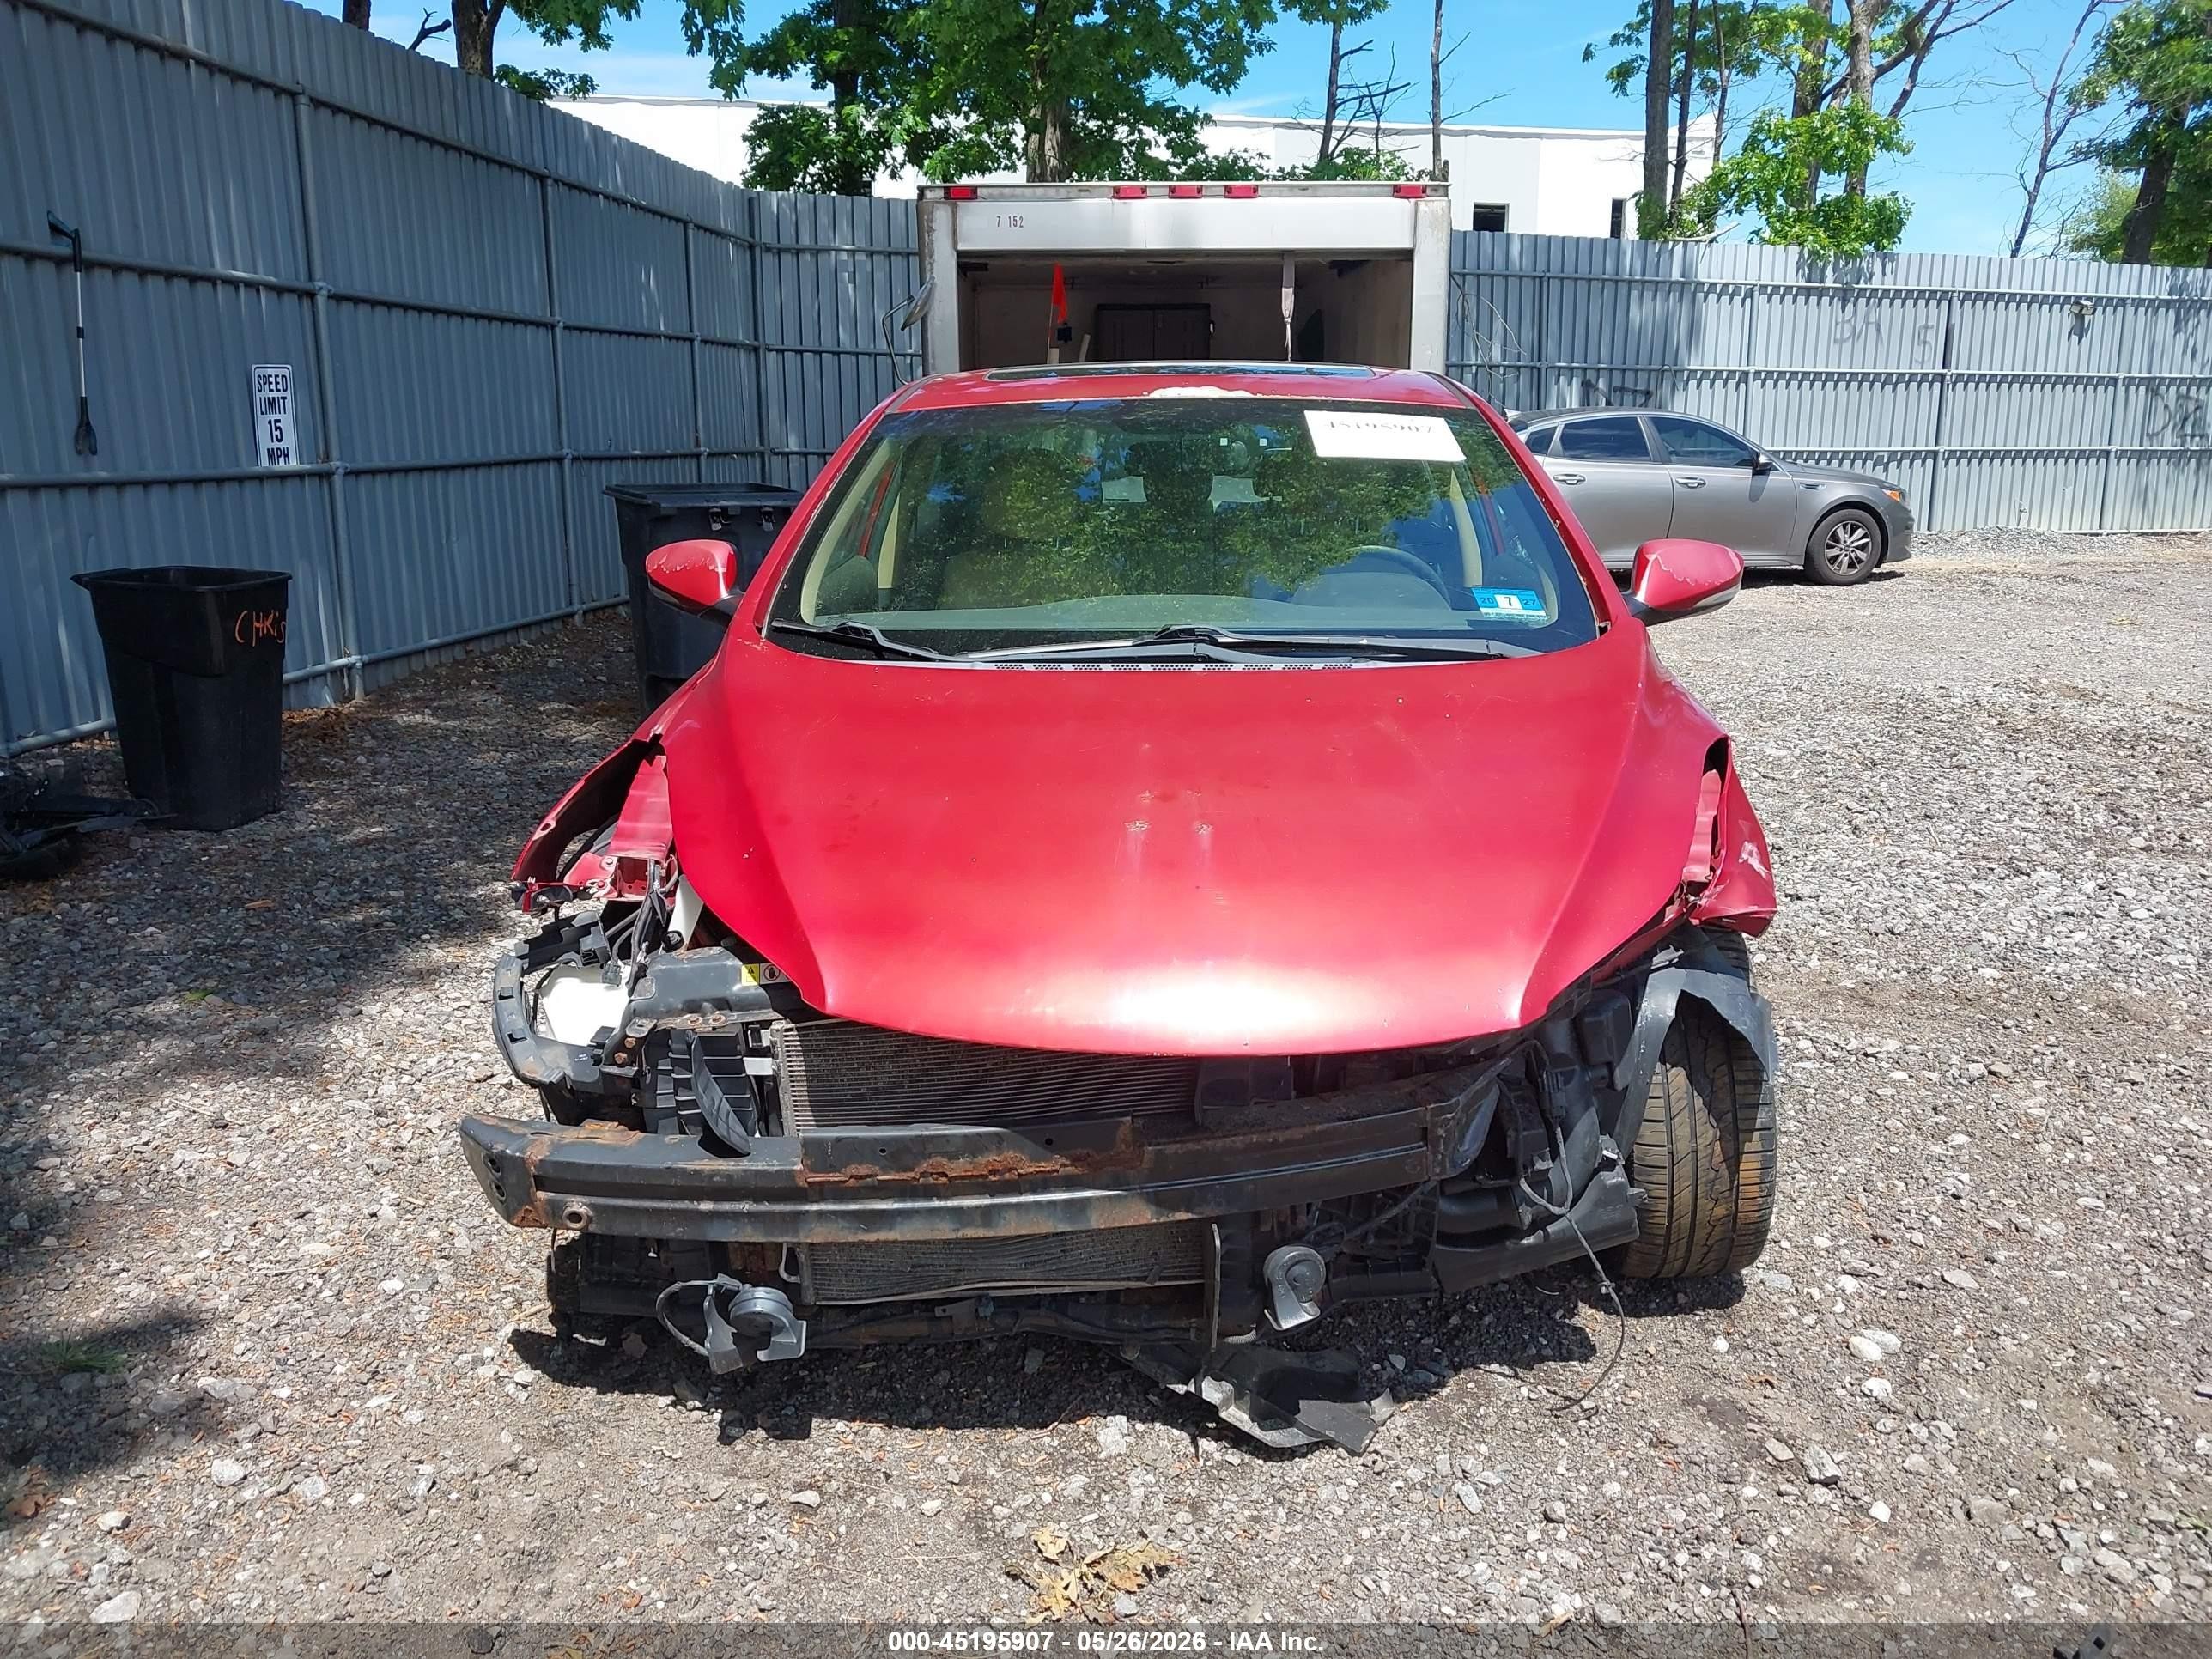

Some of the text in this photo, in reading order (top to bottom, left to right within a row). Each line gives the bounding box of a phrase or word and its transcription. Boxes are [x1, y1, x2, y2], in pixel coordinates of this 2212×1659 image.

[996, 215, 1024, 228] 7 152
[257, 374, 288, 392] SPEED
[259, 396, 287, 415] LIMIT
[267, 418, 283, 443] 15
[266, 447, 290, 466] MPH
[1504, 596, 1514, 607] 7
